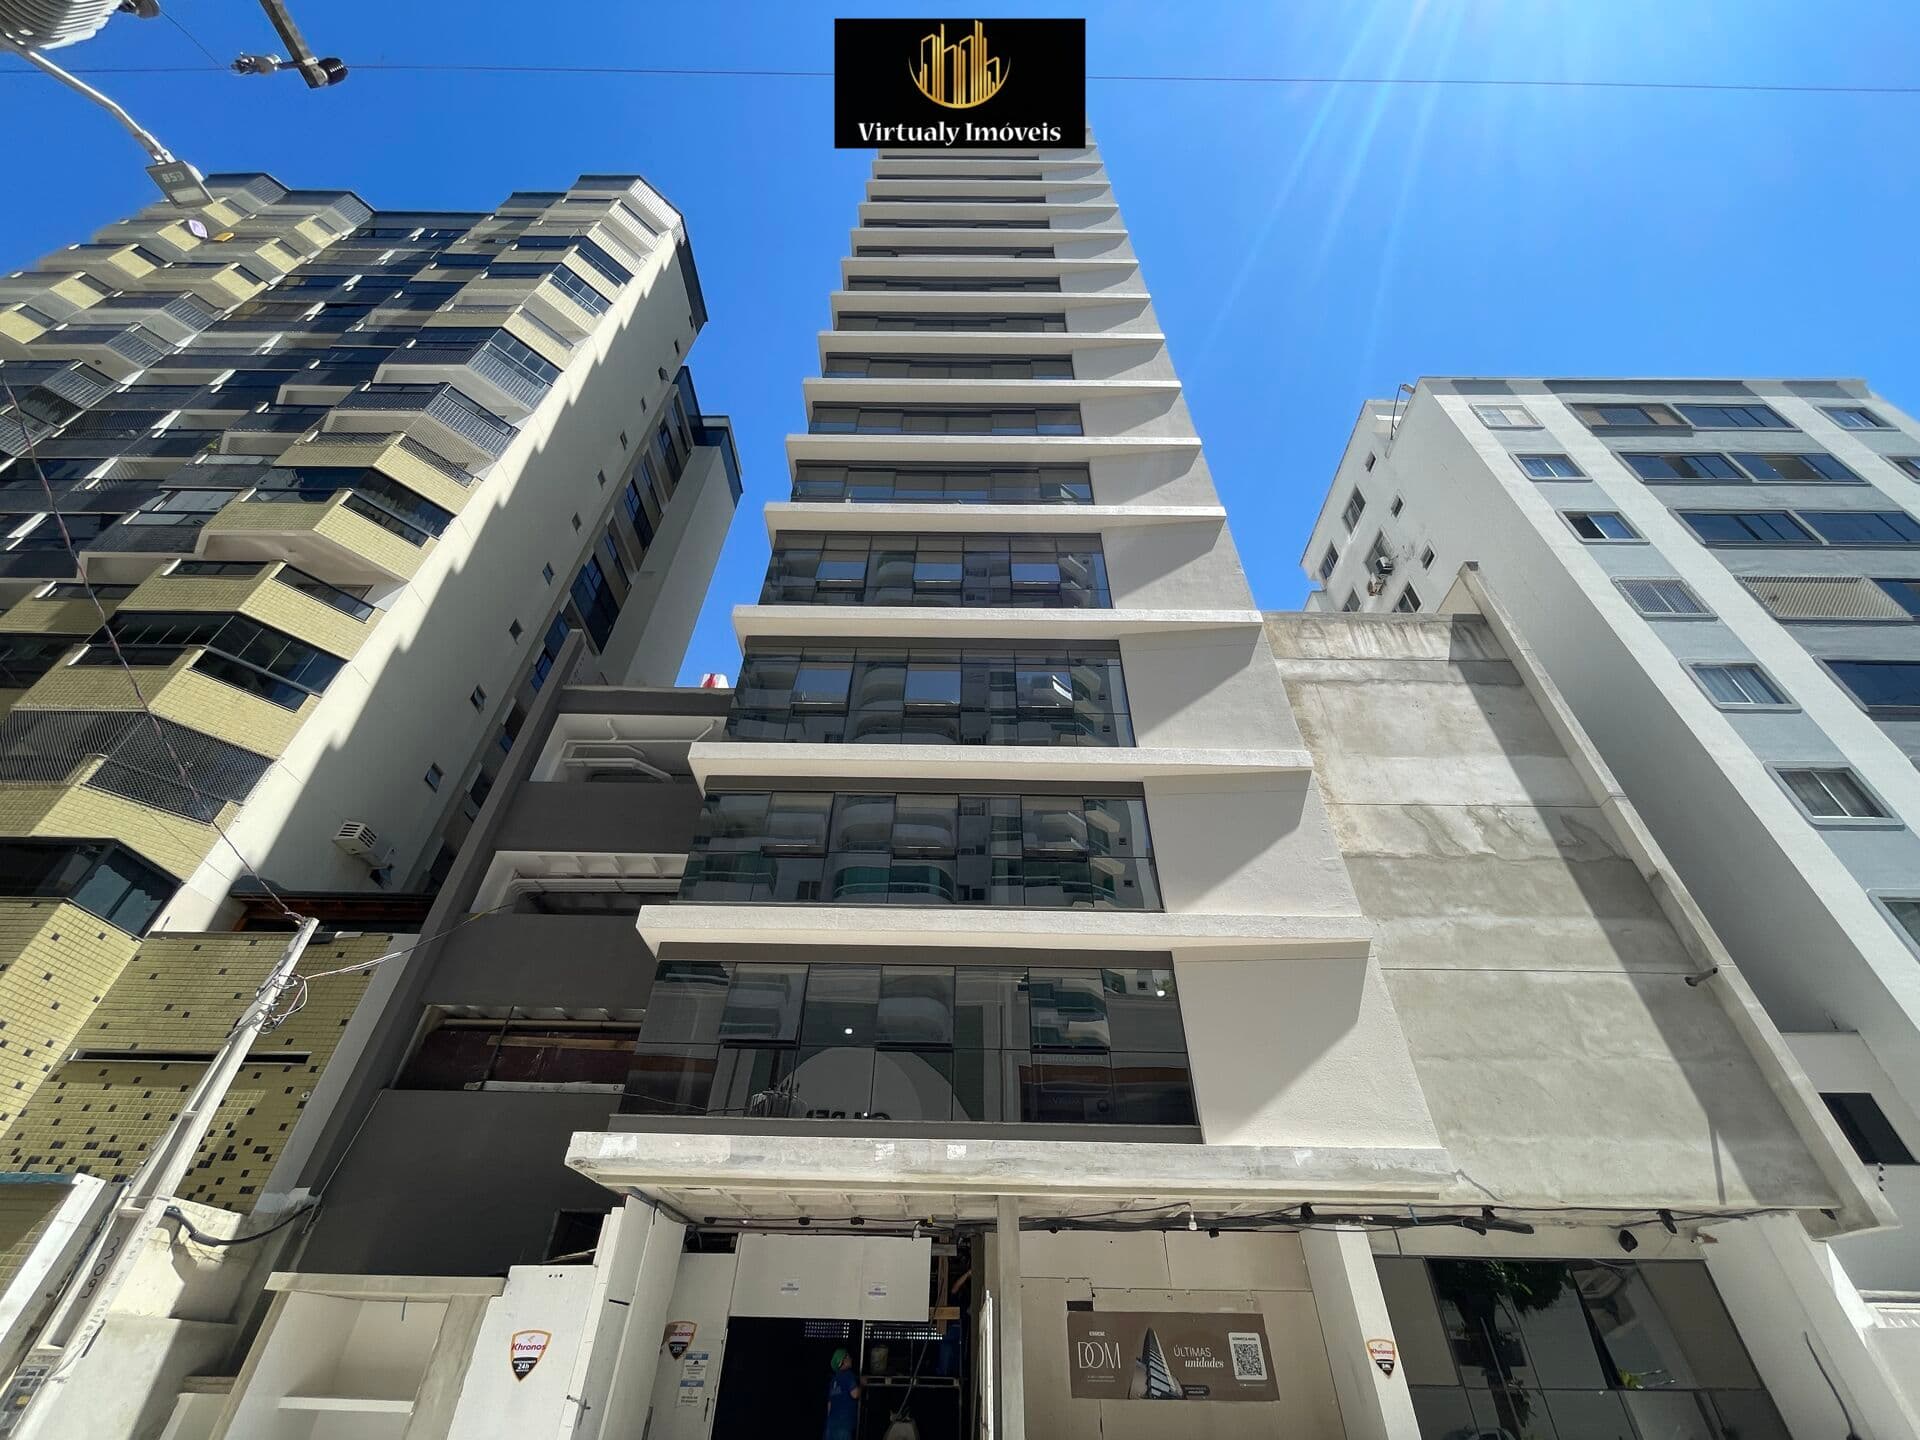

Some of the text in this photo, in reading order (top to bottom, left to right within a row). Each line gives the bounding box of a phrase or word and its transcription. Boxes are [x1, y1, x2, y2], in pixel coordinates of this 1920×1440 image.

[512, 1343, 547, 1351] Khronos
[1173, 1344, 1212, 1358] ÚLTIMAS
[1078, 1341, 1121, 1369] DOM
[1184, 1356, 1225, 1368] unidades
